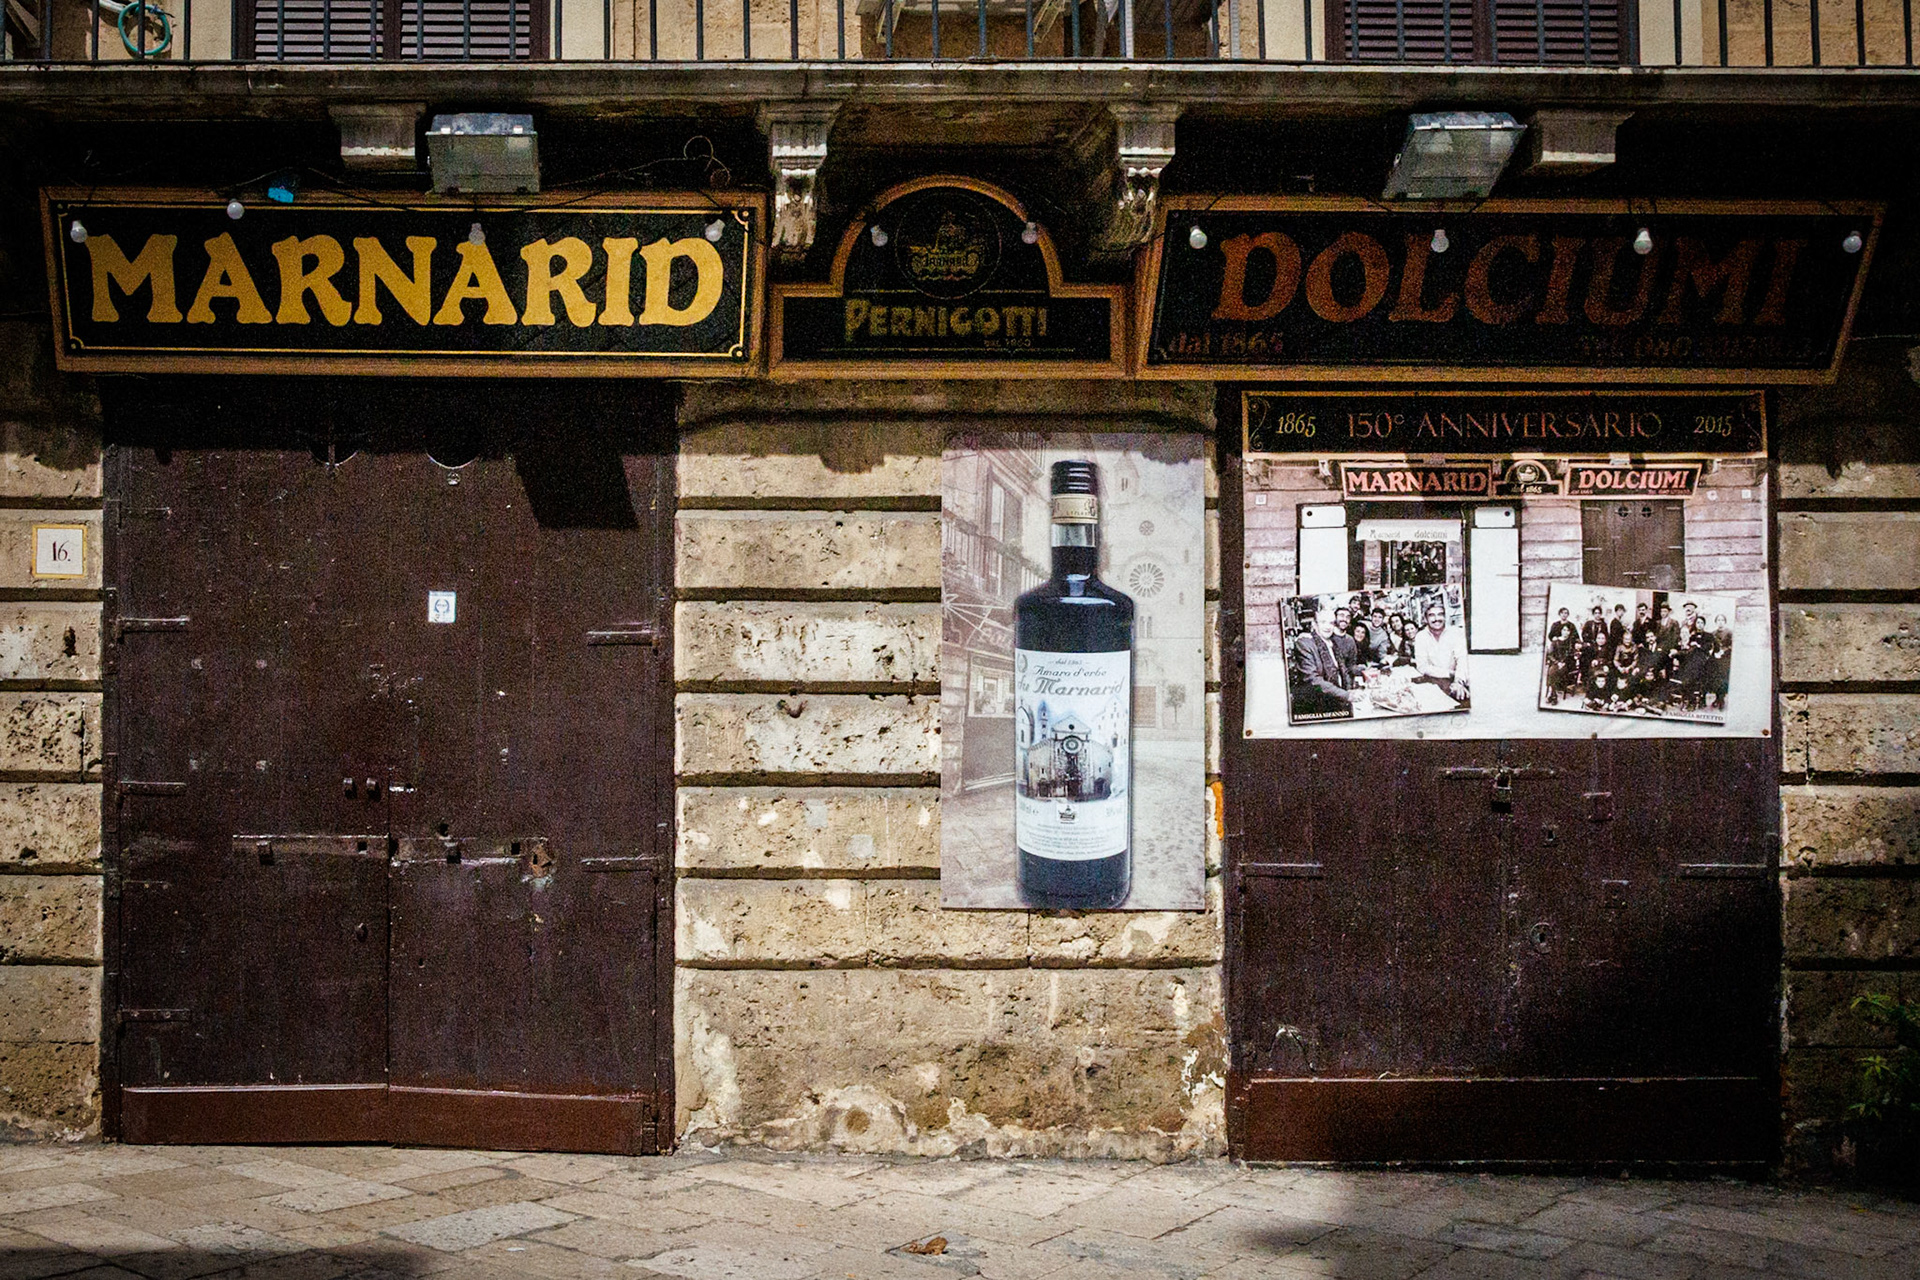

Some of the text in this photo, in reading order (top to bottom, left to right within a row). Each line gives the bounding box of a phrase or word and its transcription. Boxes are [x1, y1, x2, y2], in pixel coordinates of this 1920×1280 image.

[86, 233, 724, 327] MARNARID
[1210, 230, 1805, 326] DOLCIUMI
[845, 299, 1048, 341] PERNIGOTTI
[1220, 331, 1284, 354] 1865
[1275, 412, 1316, 438] 1865
[1416, 411, 1663, 438] ANNIVERSARIO
[1694, 414, 1733, 437] 2015
[1346, 471, 1488, 492] MARNARID
[1578, 470, 1690, 489] DOLCIUMI
[1033, 664, 1108, 677] Amaro d'erbe
[1032, 676, 1125, 696] Marnarid
